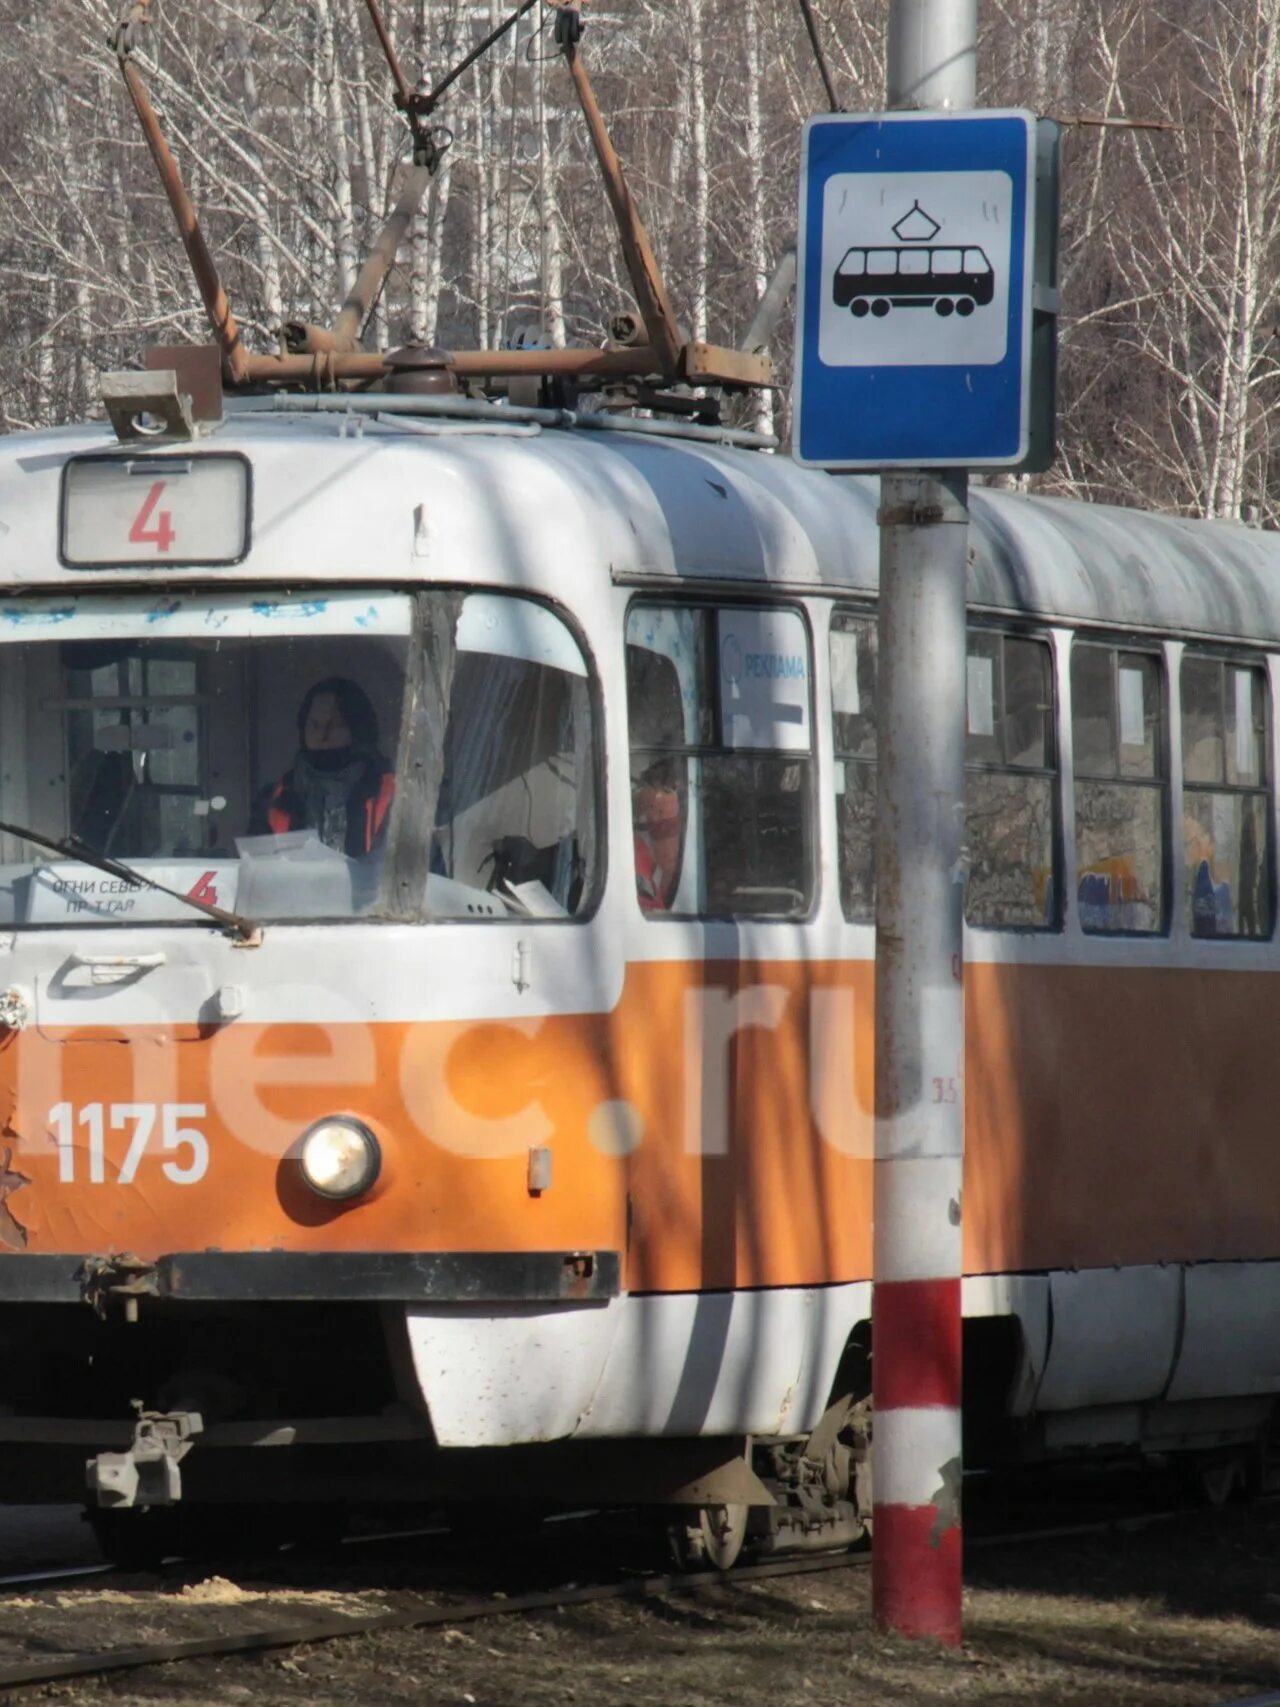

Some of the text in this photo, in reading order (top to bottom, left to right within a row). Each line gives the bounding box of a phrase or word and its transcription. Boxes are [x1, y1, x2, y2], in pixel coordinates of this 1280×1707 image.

[129, 480, 175, 552] 4
[745, 653, 805, 680] РЕКЛАМА
[53, 880, 96, 894] ОГНИ
[185, 871, 218, 907] 4
[106, 899, 136, 913] ГАЯ
[48, 1102, 210, 1185] 1175
